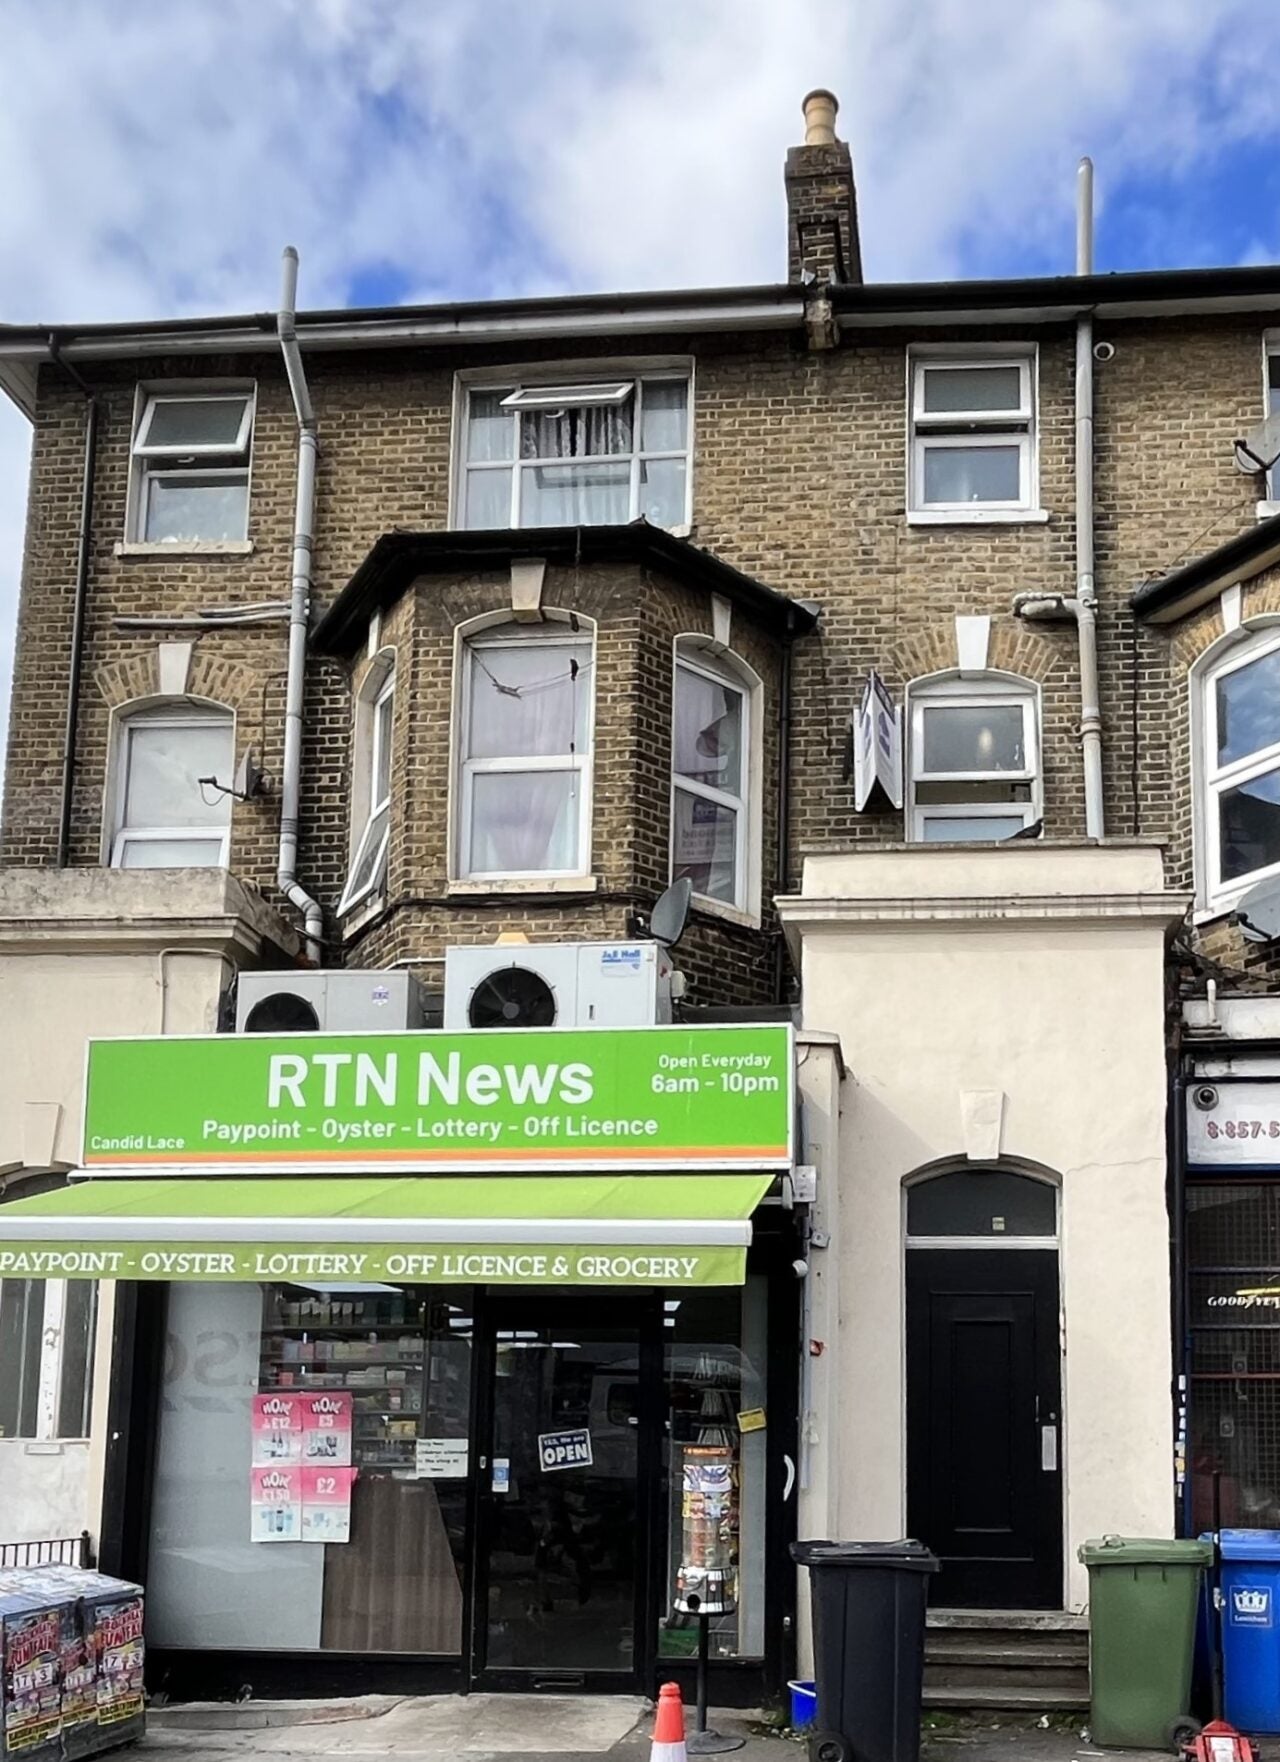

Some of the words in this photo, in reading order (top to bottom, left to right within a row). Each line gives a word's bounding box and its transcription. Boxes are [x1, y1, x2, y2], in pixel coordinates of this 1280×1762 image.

[658, 1054, 698, 1070] Open
[701, 1053, 772, 1070] Everyday
[267, 1053, 398, 1109] RTN
[417, 1051, 594, 1106] News
[651, 1073, 700, 1093] 6am
[720, 1072, 780, 1096] 10pm
[202, 1118, 301, 1146] Paypoint
[322, 1117, 397, 1143] Oyster
[416, 1116, 503, 1142] Lottery
[523, 1115, 560, 1137] Off
[565, 1116, 658, 1137] Licence
[91, 1136, 144, 1150] Candid
[147, 1136, 186, 1150] Lace
[0, 1251, 123, 1273] PAYPOINT
[141, 1252, 237, 1273] OYSTER
[255, 1253, 368, 1275] LOTTERY
[386, 1254, 437, 1275] OFF
[441, 1254, 548, 1277] LICENCE
[551, 1256, 570, 1276] &
[576, 1256, 700, 1279] GROCERY
[543, 1443, 588, 1465] OPEN
[316, 1477, 337, 1495] £2
